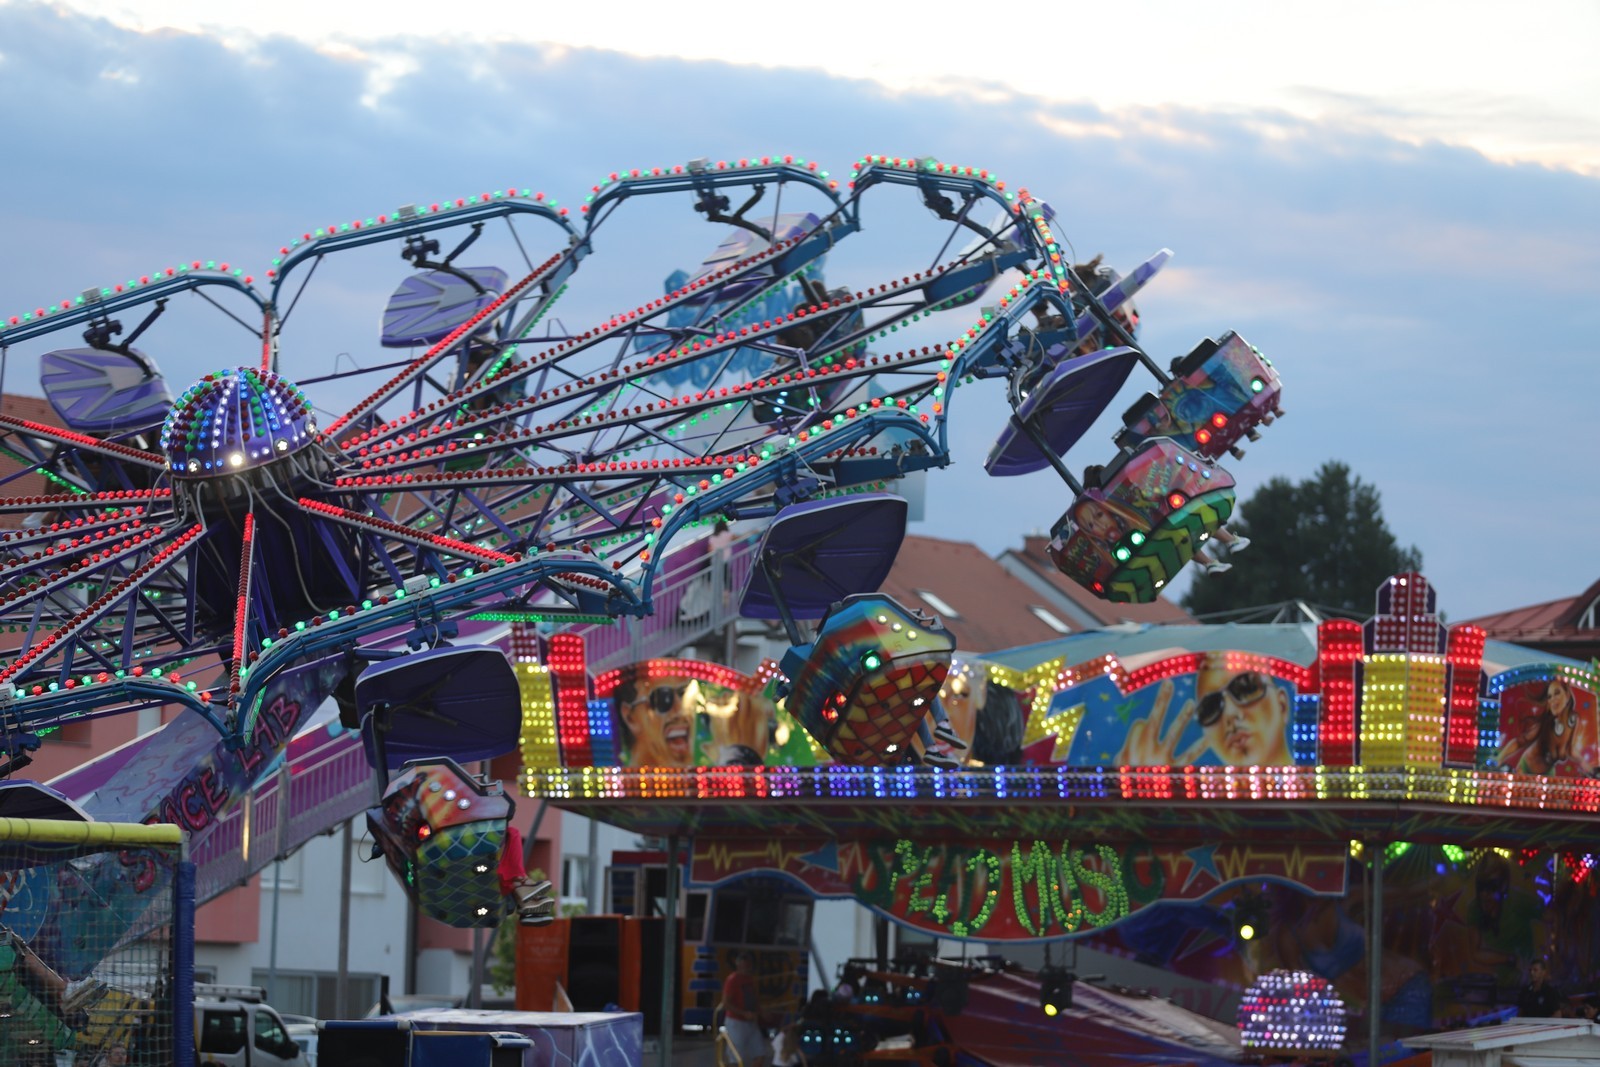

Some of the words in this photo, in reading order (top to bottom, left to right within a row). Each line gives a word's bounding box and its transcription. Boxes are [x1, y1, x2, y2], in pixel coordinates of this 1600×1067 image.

[118, 767, 230, 894] SACE
[236, 693, 301, 778] LAB
[853, 838, 1002, 938] SPEED
[1010, 837, 1166, 937] MUSIC
